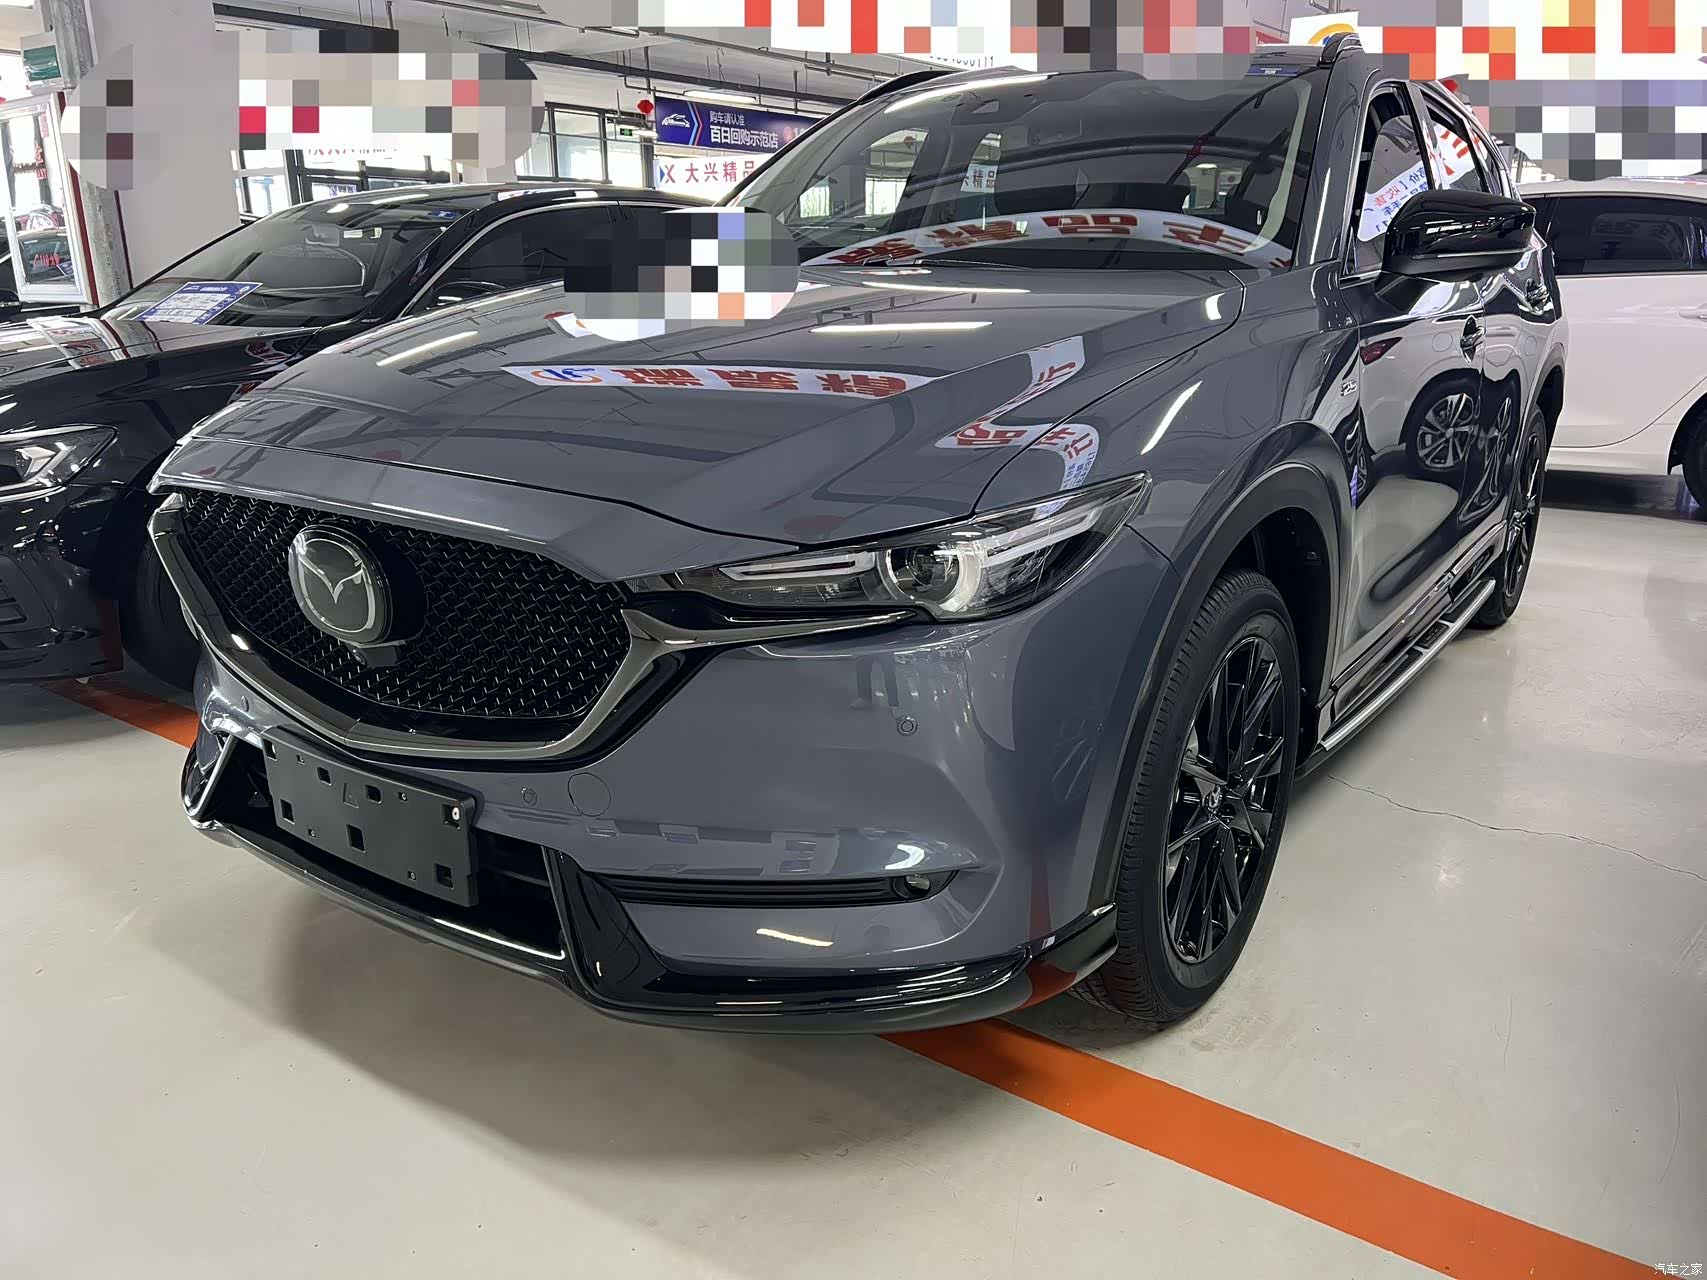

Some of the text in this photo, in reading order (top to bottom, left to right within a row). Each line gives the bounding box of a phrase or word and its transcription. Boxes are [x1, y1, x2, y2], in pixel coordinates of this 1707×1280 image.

[710, 126, 779, 149] 百日回购示范店
